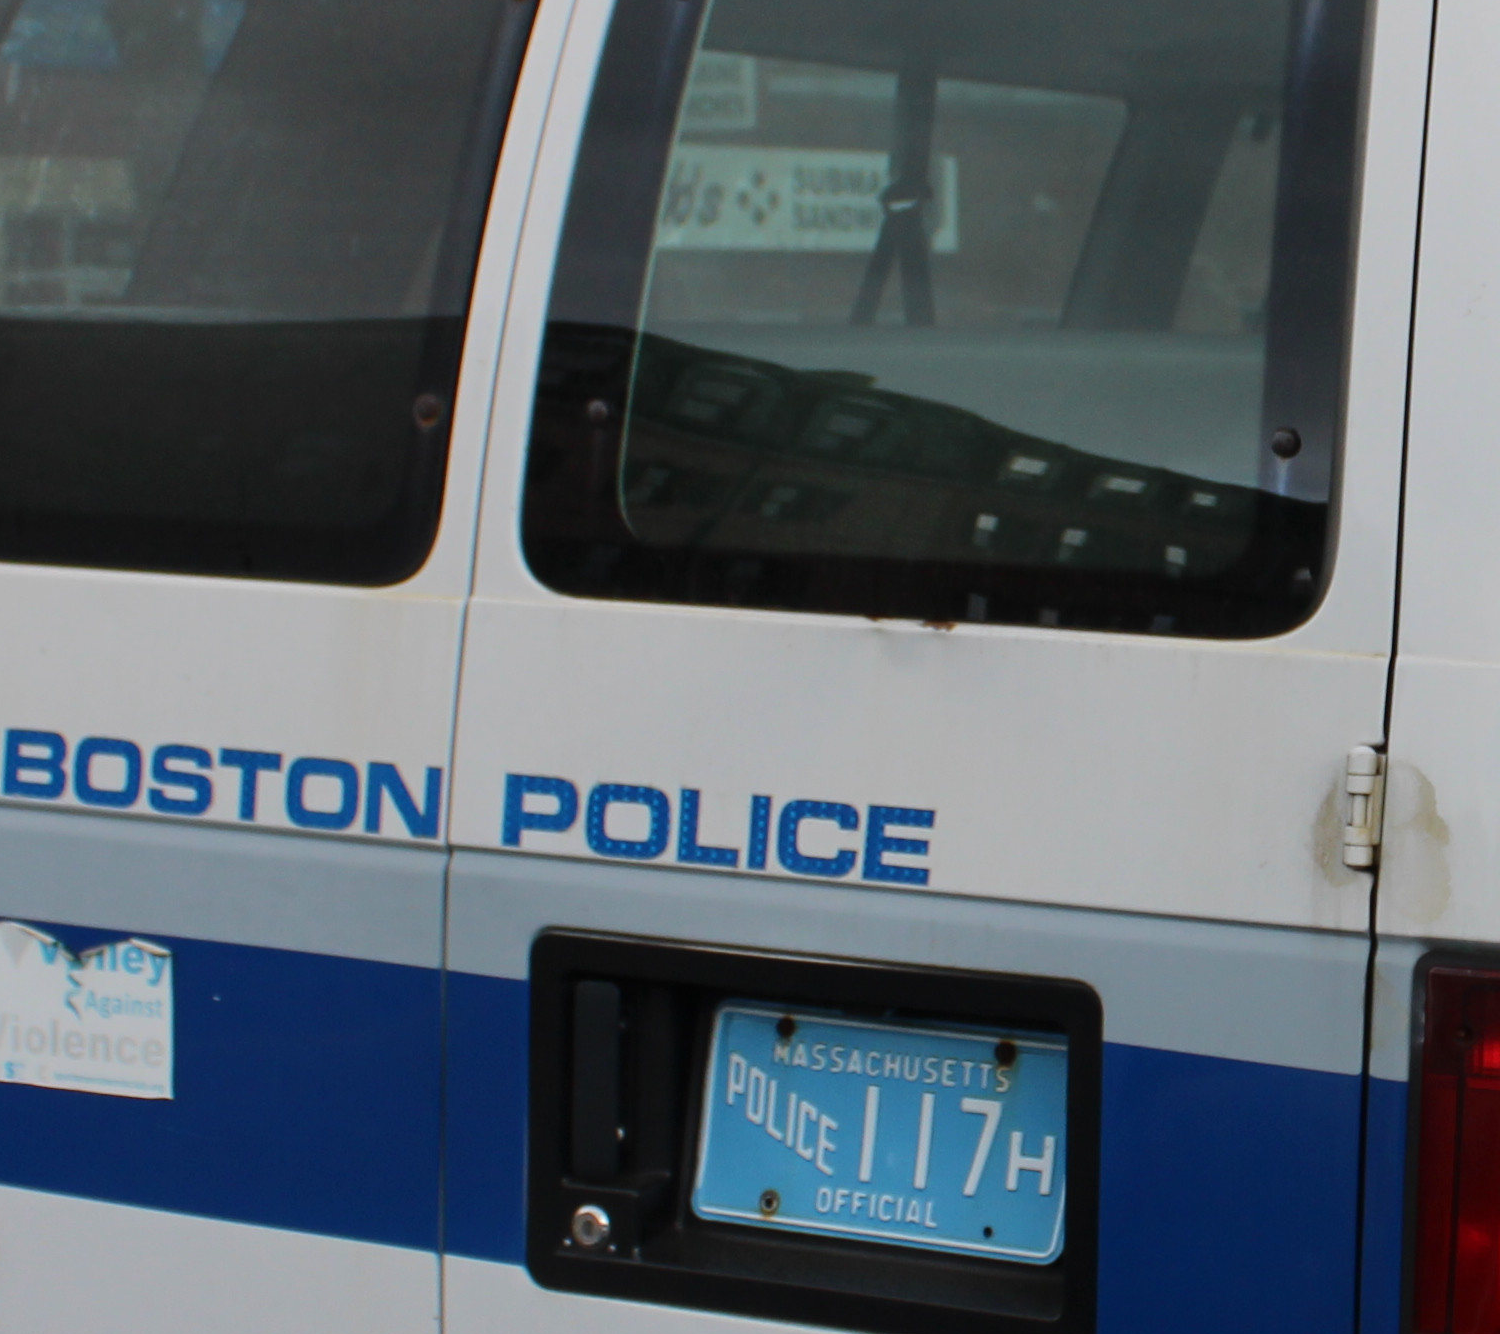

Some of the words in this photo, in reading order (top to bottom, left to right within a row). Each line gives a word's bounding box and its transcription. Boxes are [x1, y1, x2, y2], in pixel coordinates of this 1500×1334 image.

[0, 727, 444, 840] BOSTON
[500, 772, 938, 886] POLICE
[84, 989, 164, 1019] Against
[772, 1040, 1013, 1094] MASSACHUSETTS
[726, 1052, 840, 1177] POLICE
[815, 1186, 939, 1229] OFFICIAL
